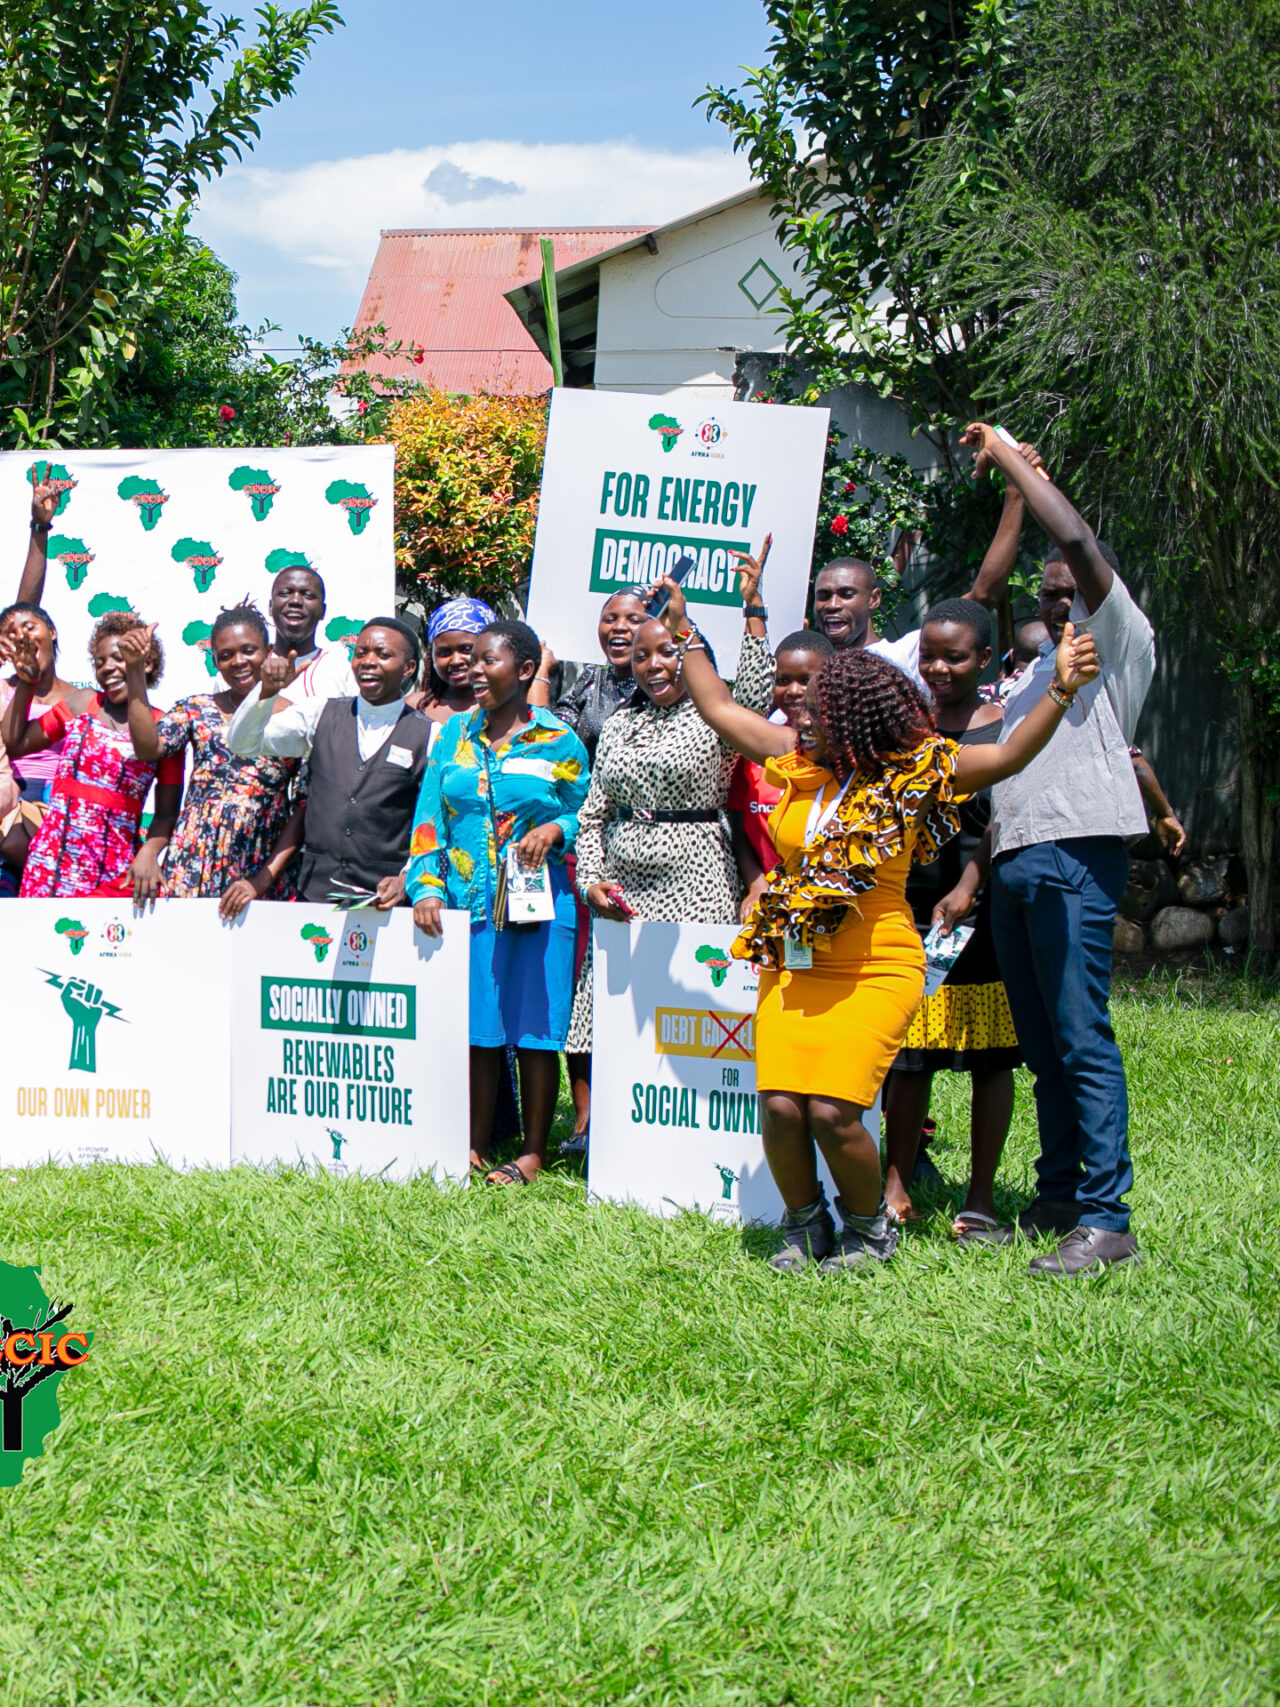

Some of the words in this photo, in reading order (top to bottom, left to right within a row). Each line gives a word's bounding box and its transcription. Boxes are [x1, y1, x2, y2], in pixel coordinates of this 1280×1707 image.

[132, 494, 169, 504] CECIC
[243, 484, 281, 495] CECIC
[340, 498, 378, 508] CECIC
[600, 471, 650, 518] FOR
[657, 476, 757, 528] ENERGY
[57, 553, 95, 563] CECIC
[185, 556, 223, 566] CECIC
[269, 983, 342, 1025] SOCIALLY
[347, 988, 408, 1030] OWNED
[660, 1014, 697, 1045] DEBT
[701, 1016, 755, 1050] CANCEL
[282, 1038, 395, 1083] RENEWABLES
[722, 1067, 740, 1087] FOR
[17, 1086, 47, 1117] OUR
[54, 1087, 90, 1118] OWN
[95, 1088, 151, 1119] POWER
[266, 1077, 297, 1115] ARE
[305, 1080, 340, 1119] OUR
[346, 1084, 413, 1126] FUTURE
[631, 1083, 700, 1128] SOCIAL
